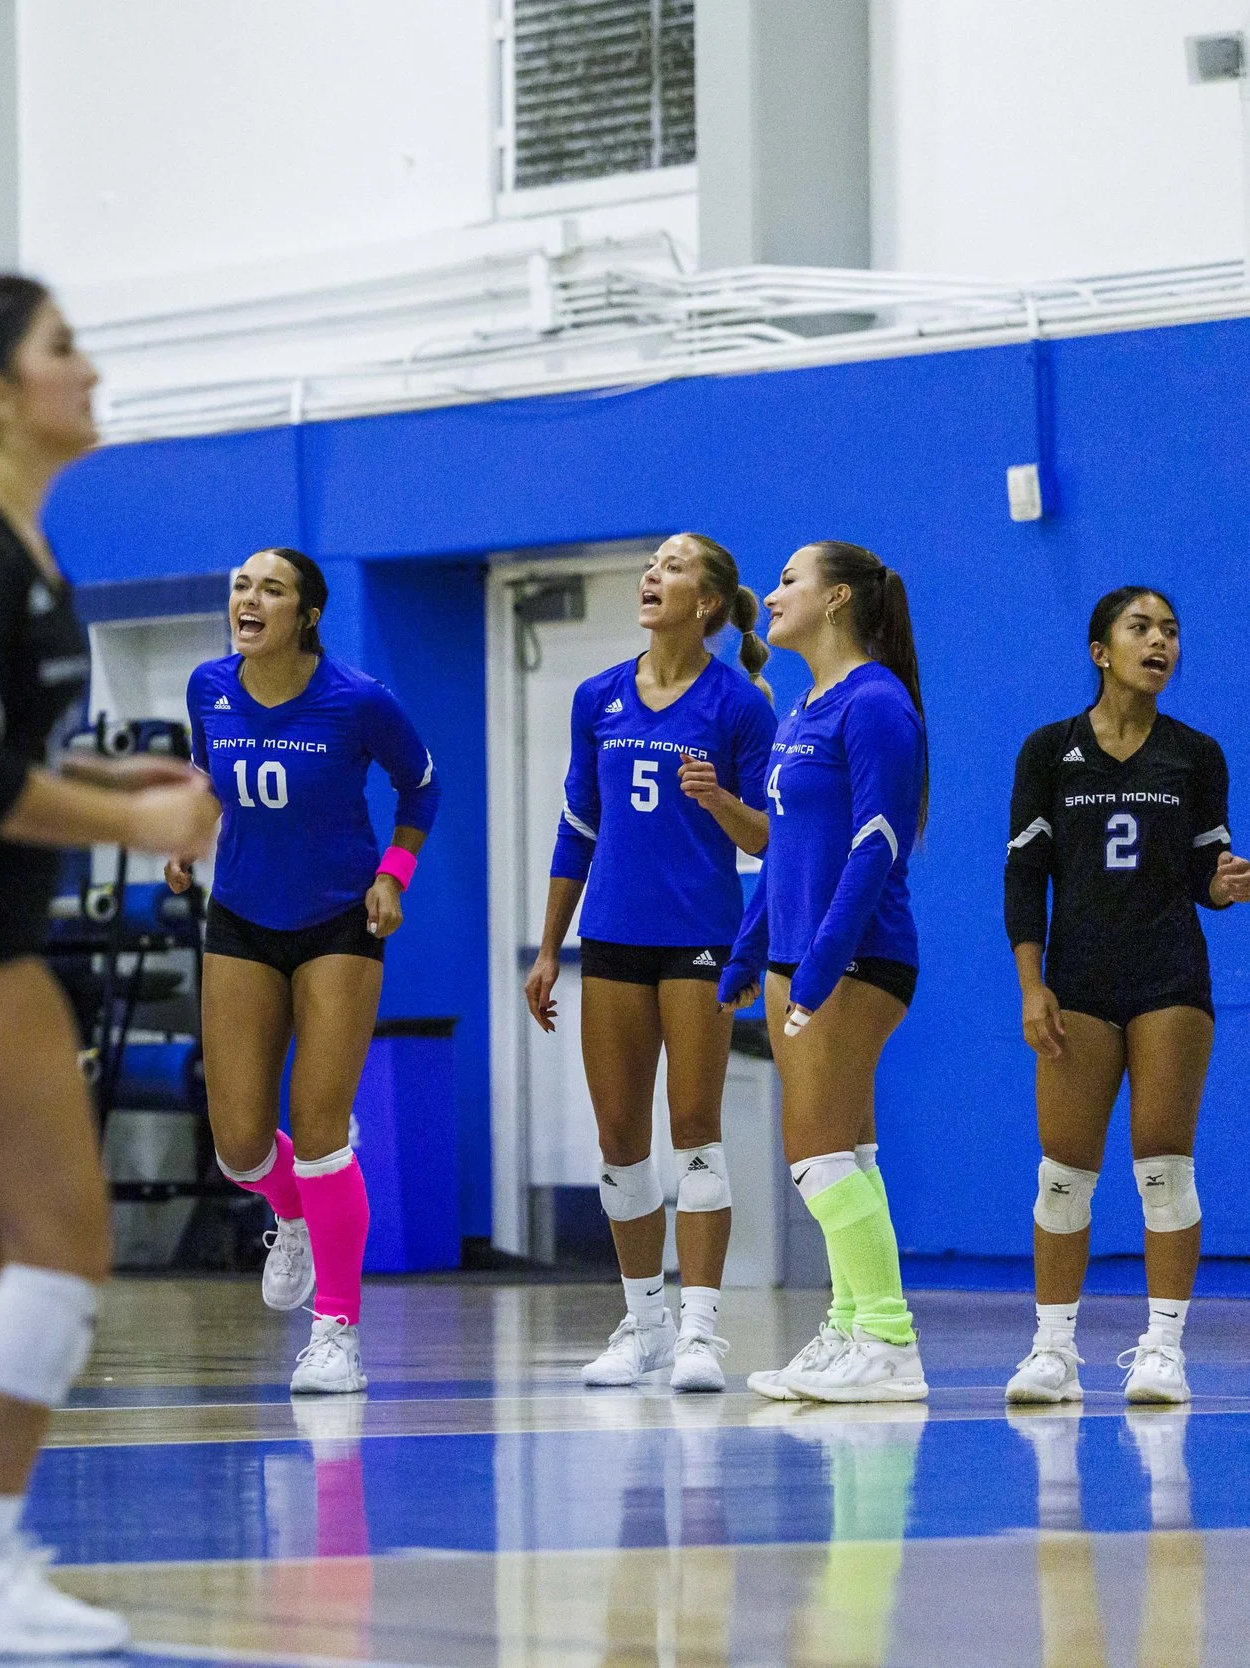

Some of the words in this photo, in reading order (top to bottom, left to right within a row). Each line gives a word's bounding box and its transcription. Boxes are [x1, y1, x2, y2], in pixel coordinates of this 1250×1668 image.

[212, 739, 256, 750] SANTA
[262, 739, 327, 753] MONICA
[603, 738, 645, 750] SANTA
[650, 741, 708, 760] MONICA
[233, 759, 289, 809] 10
[630, 759, 659, 813] 5
[766, 763, 785, 815] 4
[1065, 794, 1116, 807] SANTA
[1122, 792, 1180, 806] MONICA
[1106, 813, 1138, 868] 2
[692, 958, 717, 967] adidas
